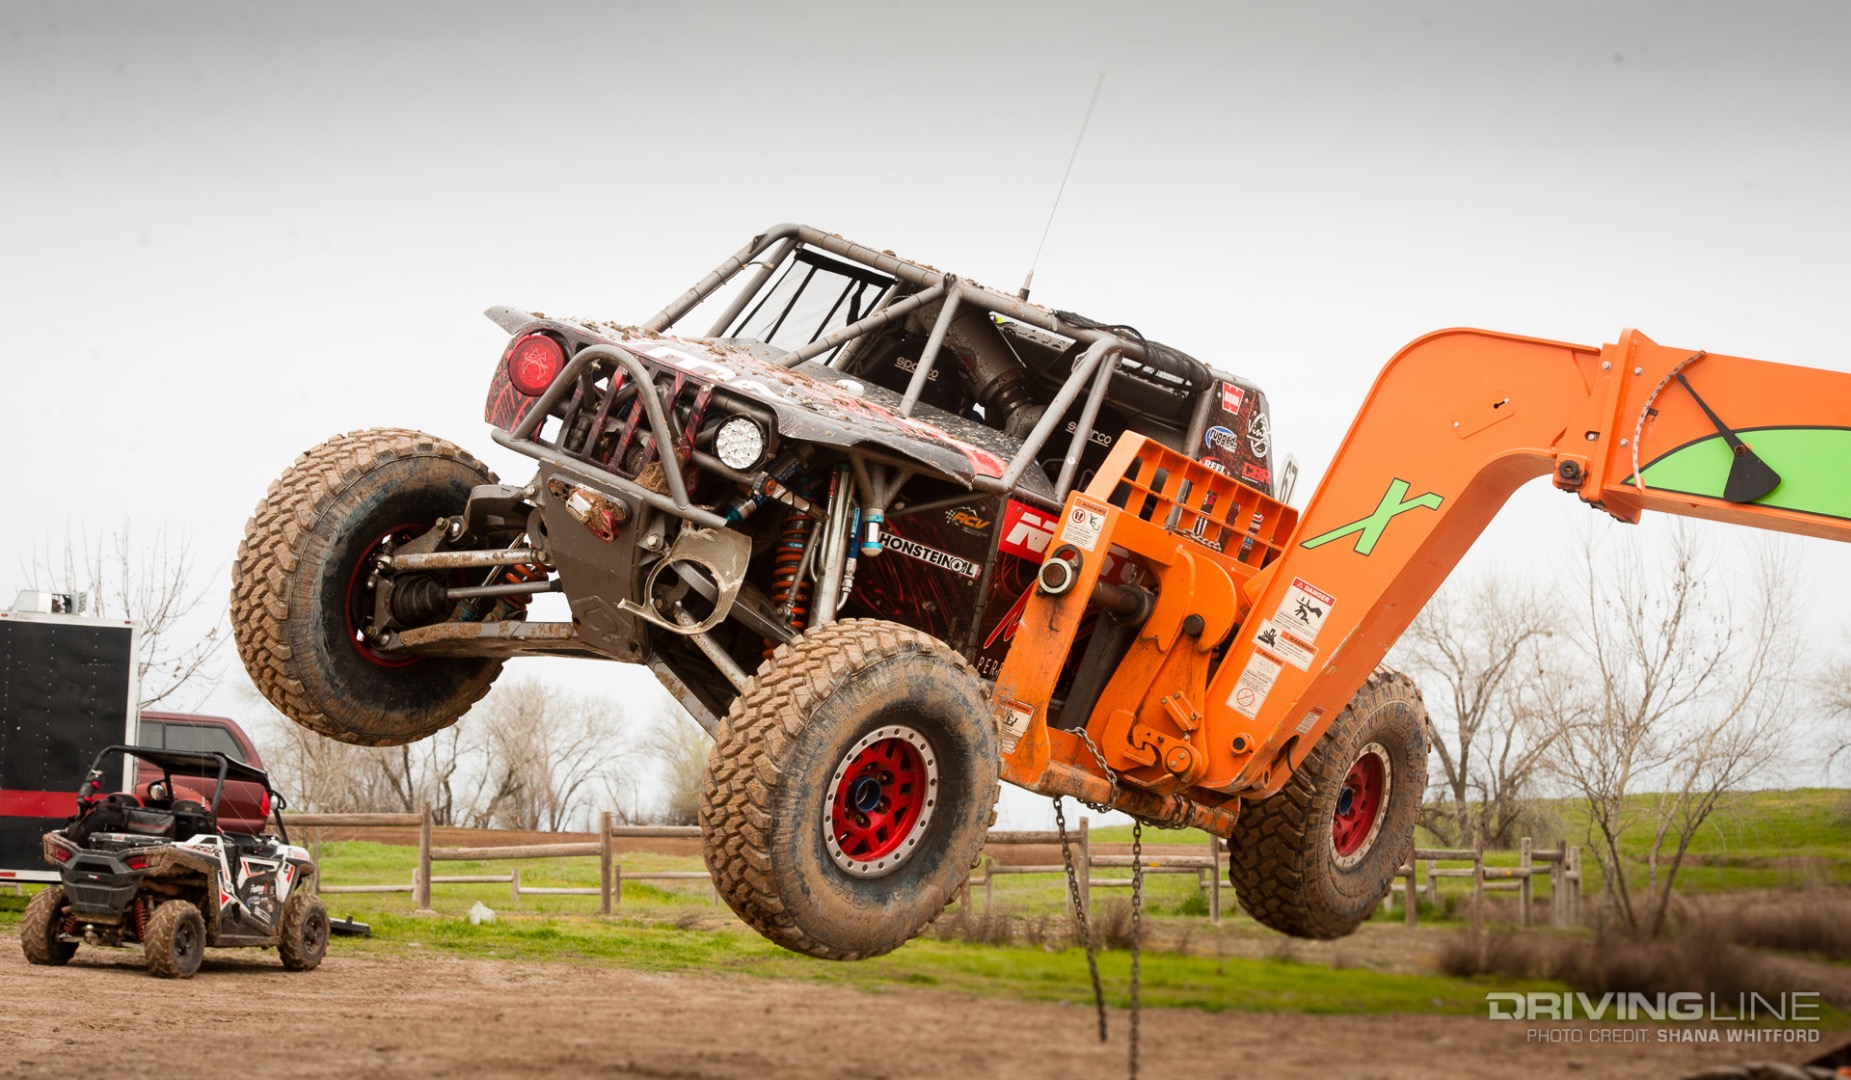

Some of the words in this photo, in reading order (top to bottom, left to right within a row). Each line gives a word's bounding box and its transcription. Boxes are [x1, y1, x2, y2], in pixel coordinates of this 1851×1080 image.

[1067, 421, 1112, 445] srco
[1082, 502, 1106, 515] WARNING
[952, 511, 991, 529] RCV
[1304, 584, 1331, 604] DANGER
[1289, 636, 1314, 653] WARNING
